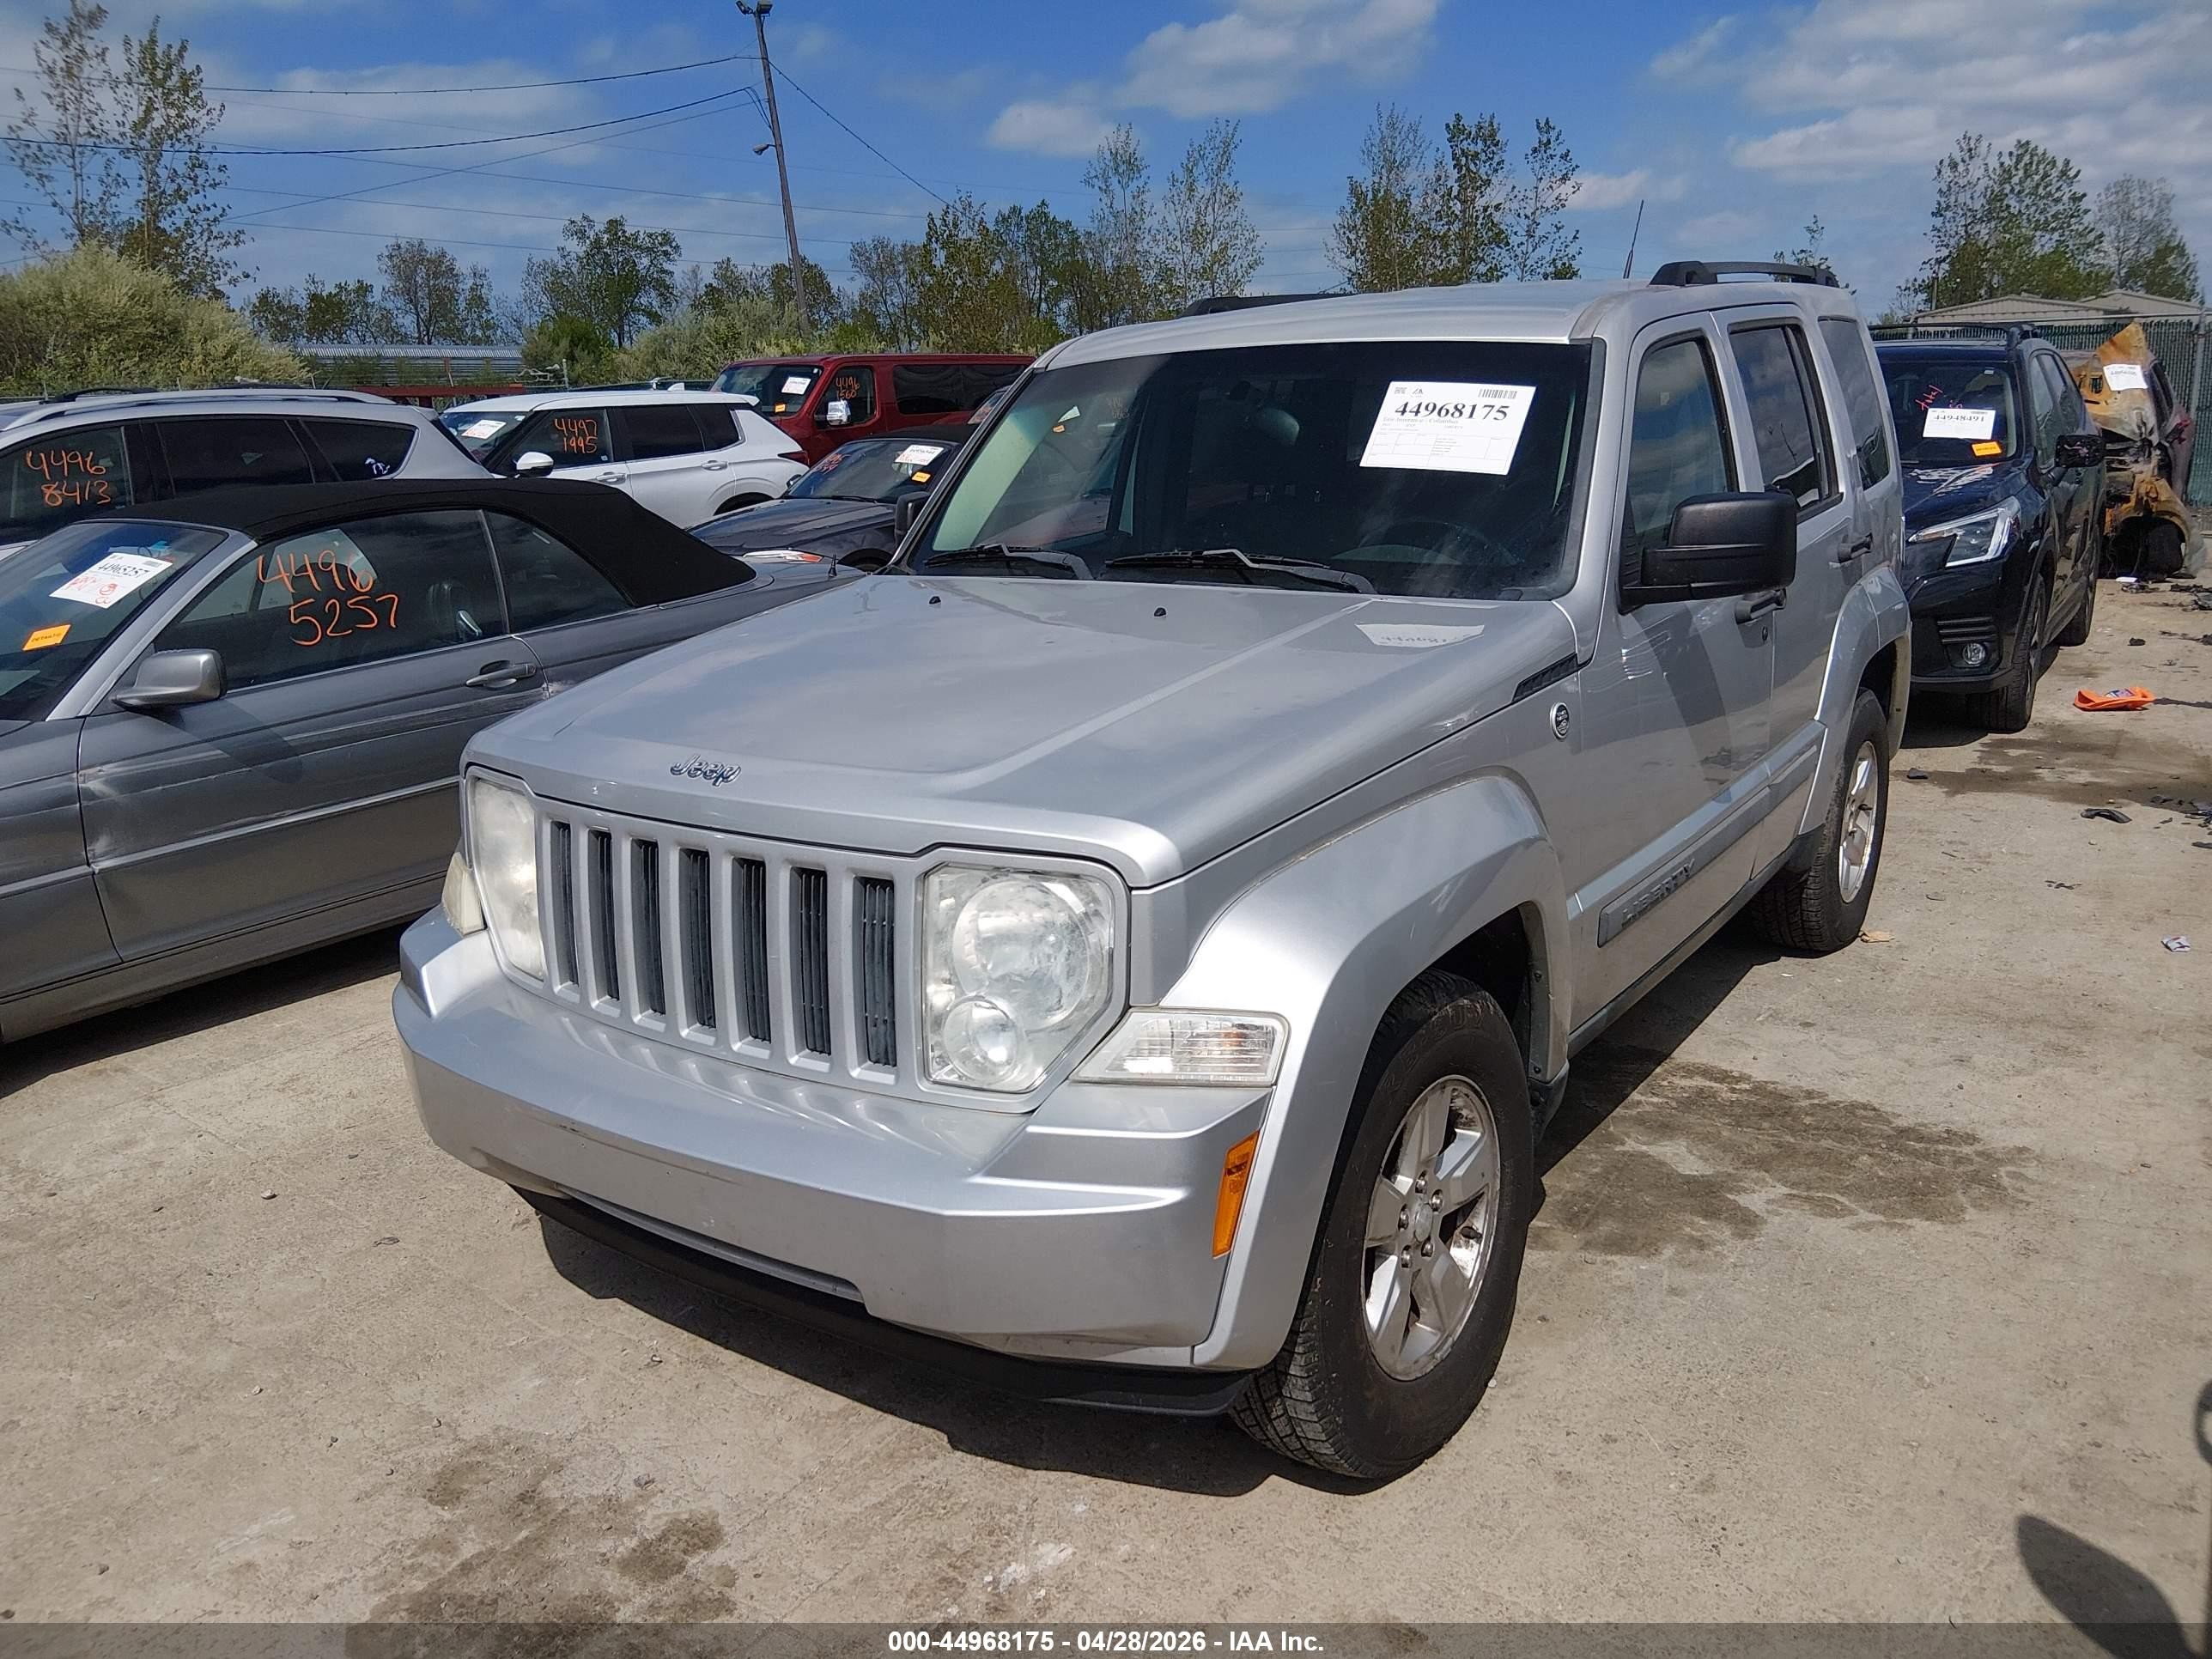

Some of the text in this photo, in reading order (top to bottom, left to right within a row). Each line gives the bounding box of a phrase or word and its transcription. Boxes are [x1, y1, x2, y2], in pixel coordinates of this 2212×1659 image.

[836, 376, 860, 392] 4496
[1395, 401, 1510, 422] 44968175
[554, 417, 598, 437] 4497
[562, 435, 599, 454] 1995
[26, 450, 106, 480] 4496
[40, 480, 112, 507] 8413
[258, 550, 374, 593] 4496
[288, 594, 398, 646] 5257
[670, 755, 742, 787] Jeep
